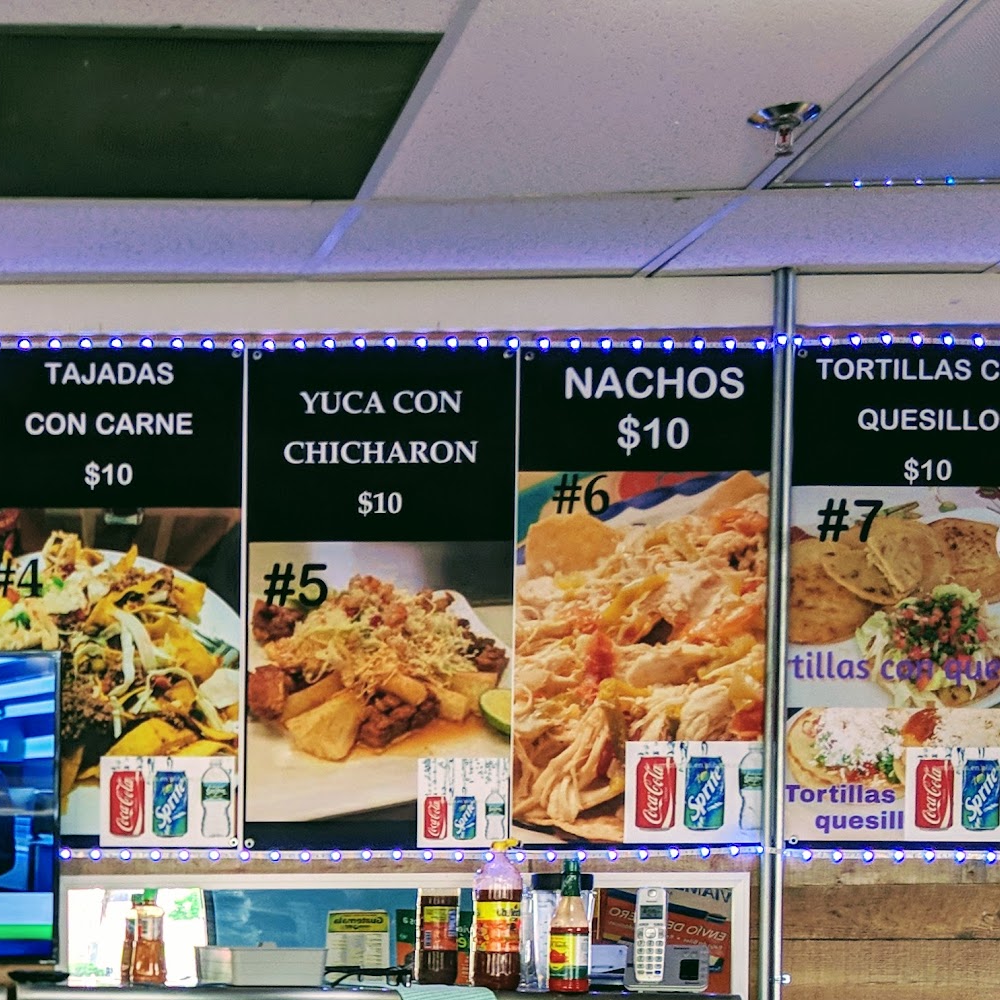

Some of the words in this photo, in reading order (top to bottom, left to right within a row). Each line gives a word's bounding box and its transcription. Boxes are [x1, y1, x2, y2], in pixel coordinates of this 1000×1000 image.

[43, 361, 175, 386] TAJADAS
[564, 365, 746, 400] NACHOS
[815, 357, 972, 382] TORTILLAS
[299, 390, 386, 415] YUCA
[392, 389, 463, 415] CON
[24, 411, 88, 436] CON
[94, 411, 194, 436] CARNE
[856, 407, 1000, 432] QUESILLO
[615, 412, 691, 457] $10
[282, 439, 480, 466] CHICHARON
[83, 459, 134, 491] $10
[902, 456, 953, 486] $10
[356, 489, 404, 518] $10
[551, 472, 612, 516] #6
[816, 497, 885, 543] #7
[263, 561, 330, 608] #5
[785, 784, 897, 804] Tortillas
